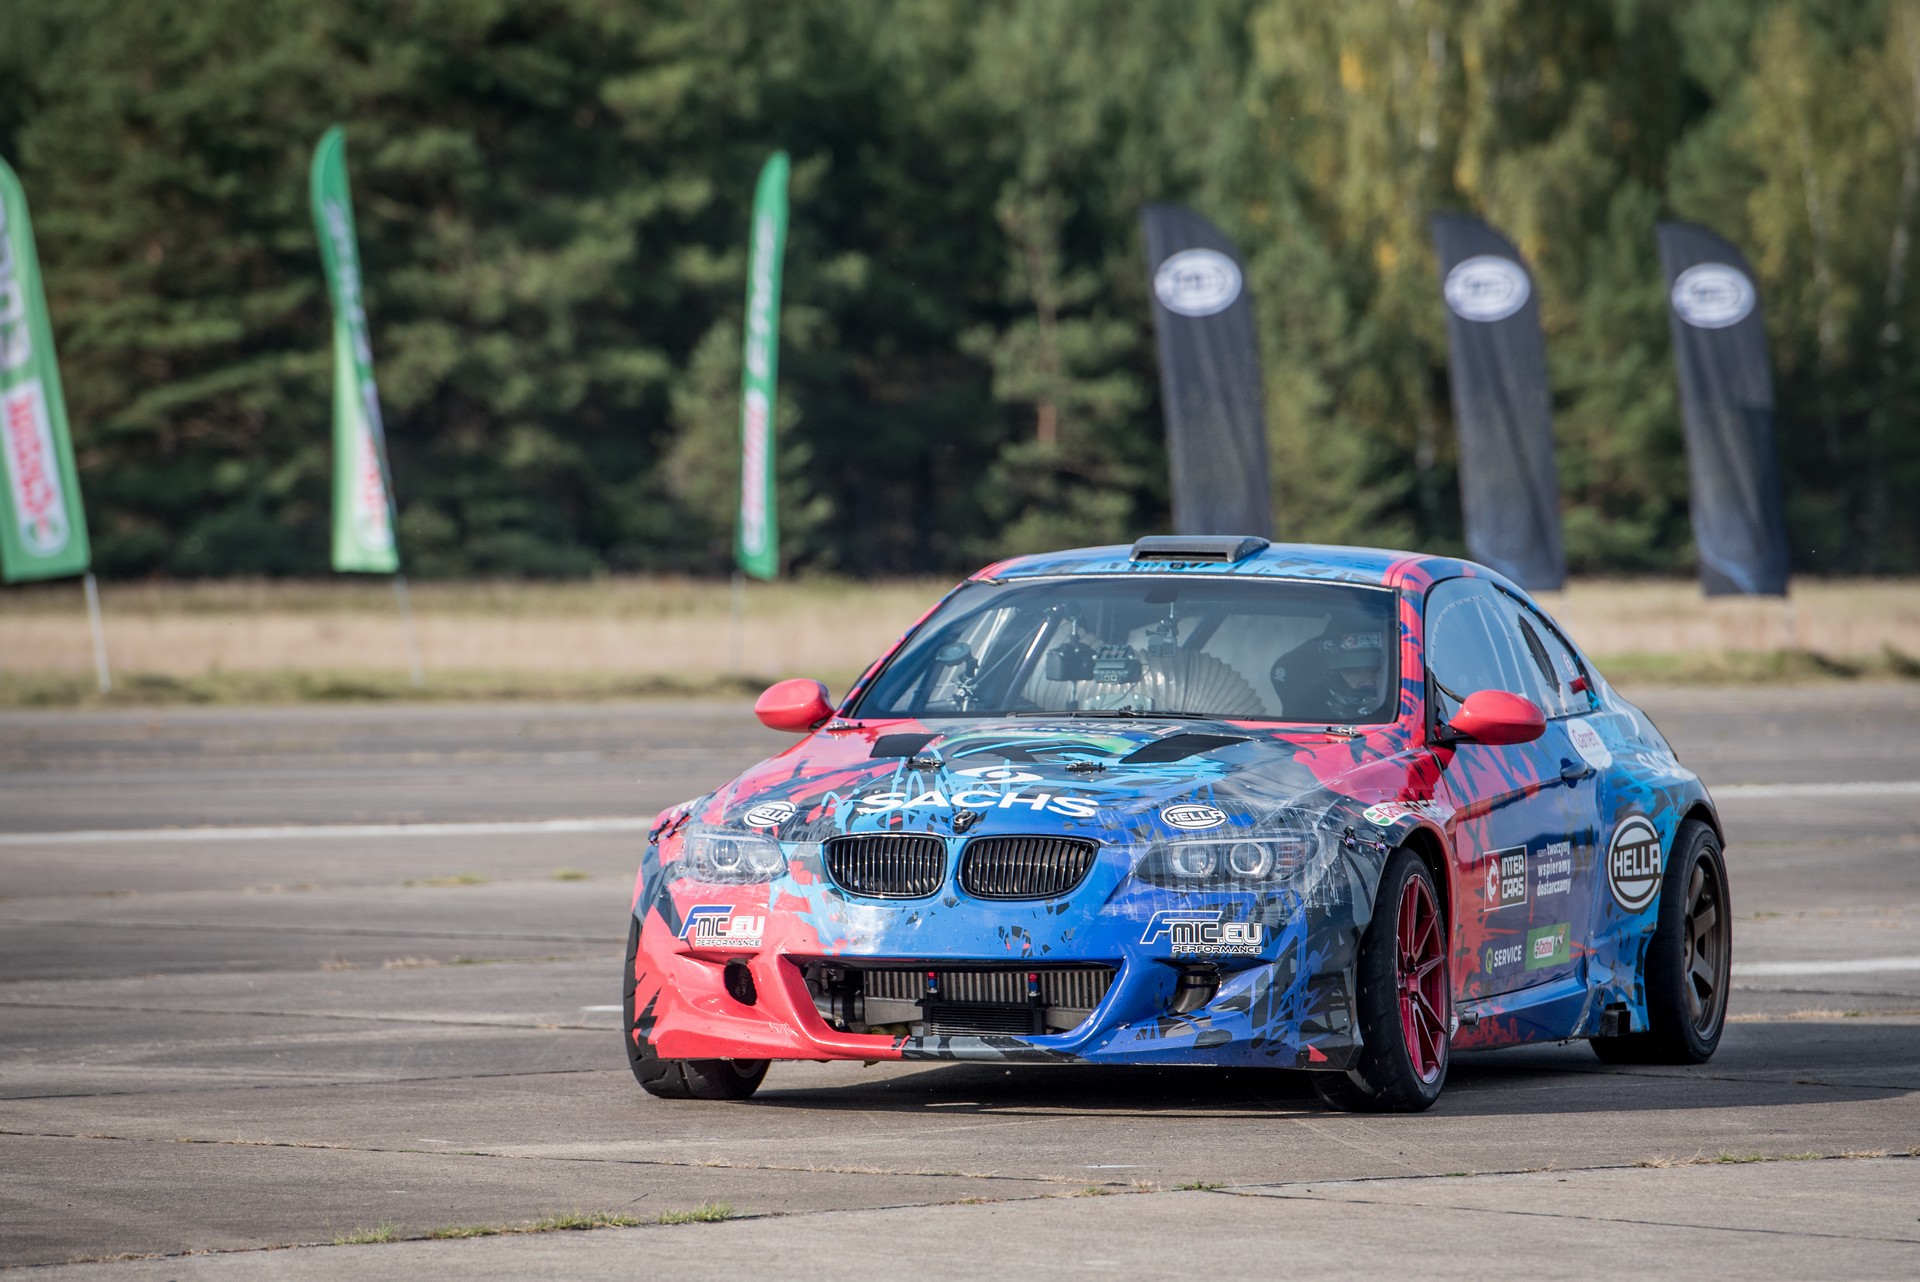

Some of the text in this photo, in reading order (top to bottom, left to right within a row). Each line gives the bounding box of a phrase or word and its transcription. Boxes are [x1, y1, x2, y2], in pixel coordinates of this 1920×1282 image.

[754, 806, 794, 823] HELLA
[856, 790, 1099, 817] SACHS
[1166, 810, 1227, 822] HELLA
[1501, 854, 1524, 876] INTER
[1537, 858, 1571, 880] wspieramy
[1613, 842, 1661, 877] HELLA
[1502, 877, 1524, 899] CARS
[1536, 879, 1571, 897] dostarczamy
[695, 939, 762, 947] PERFORMANCE
[1171, 945, 1263, 955] PERFORMANCE
[1493, 945, 1522, 967] SERVICE
